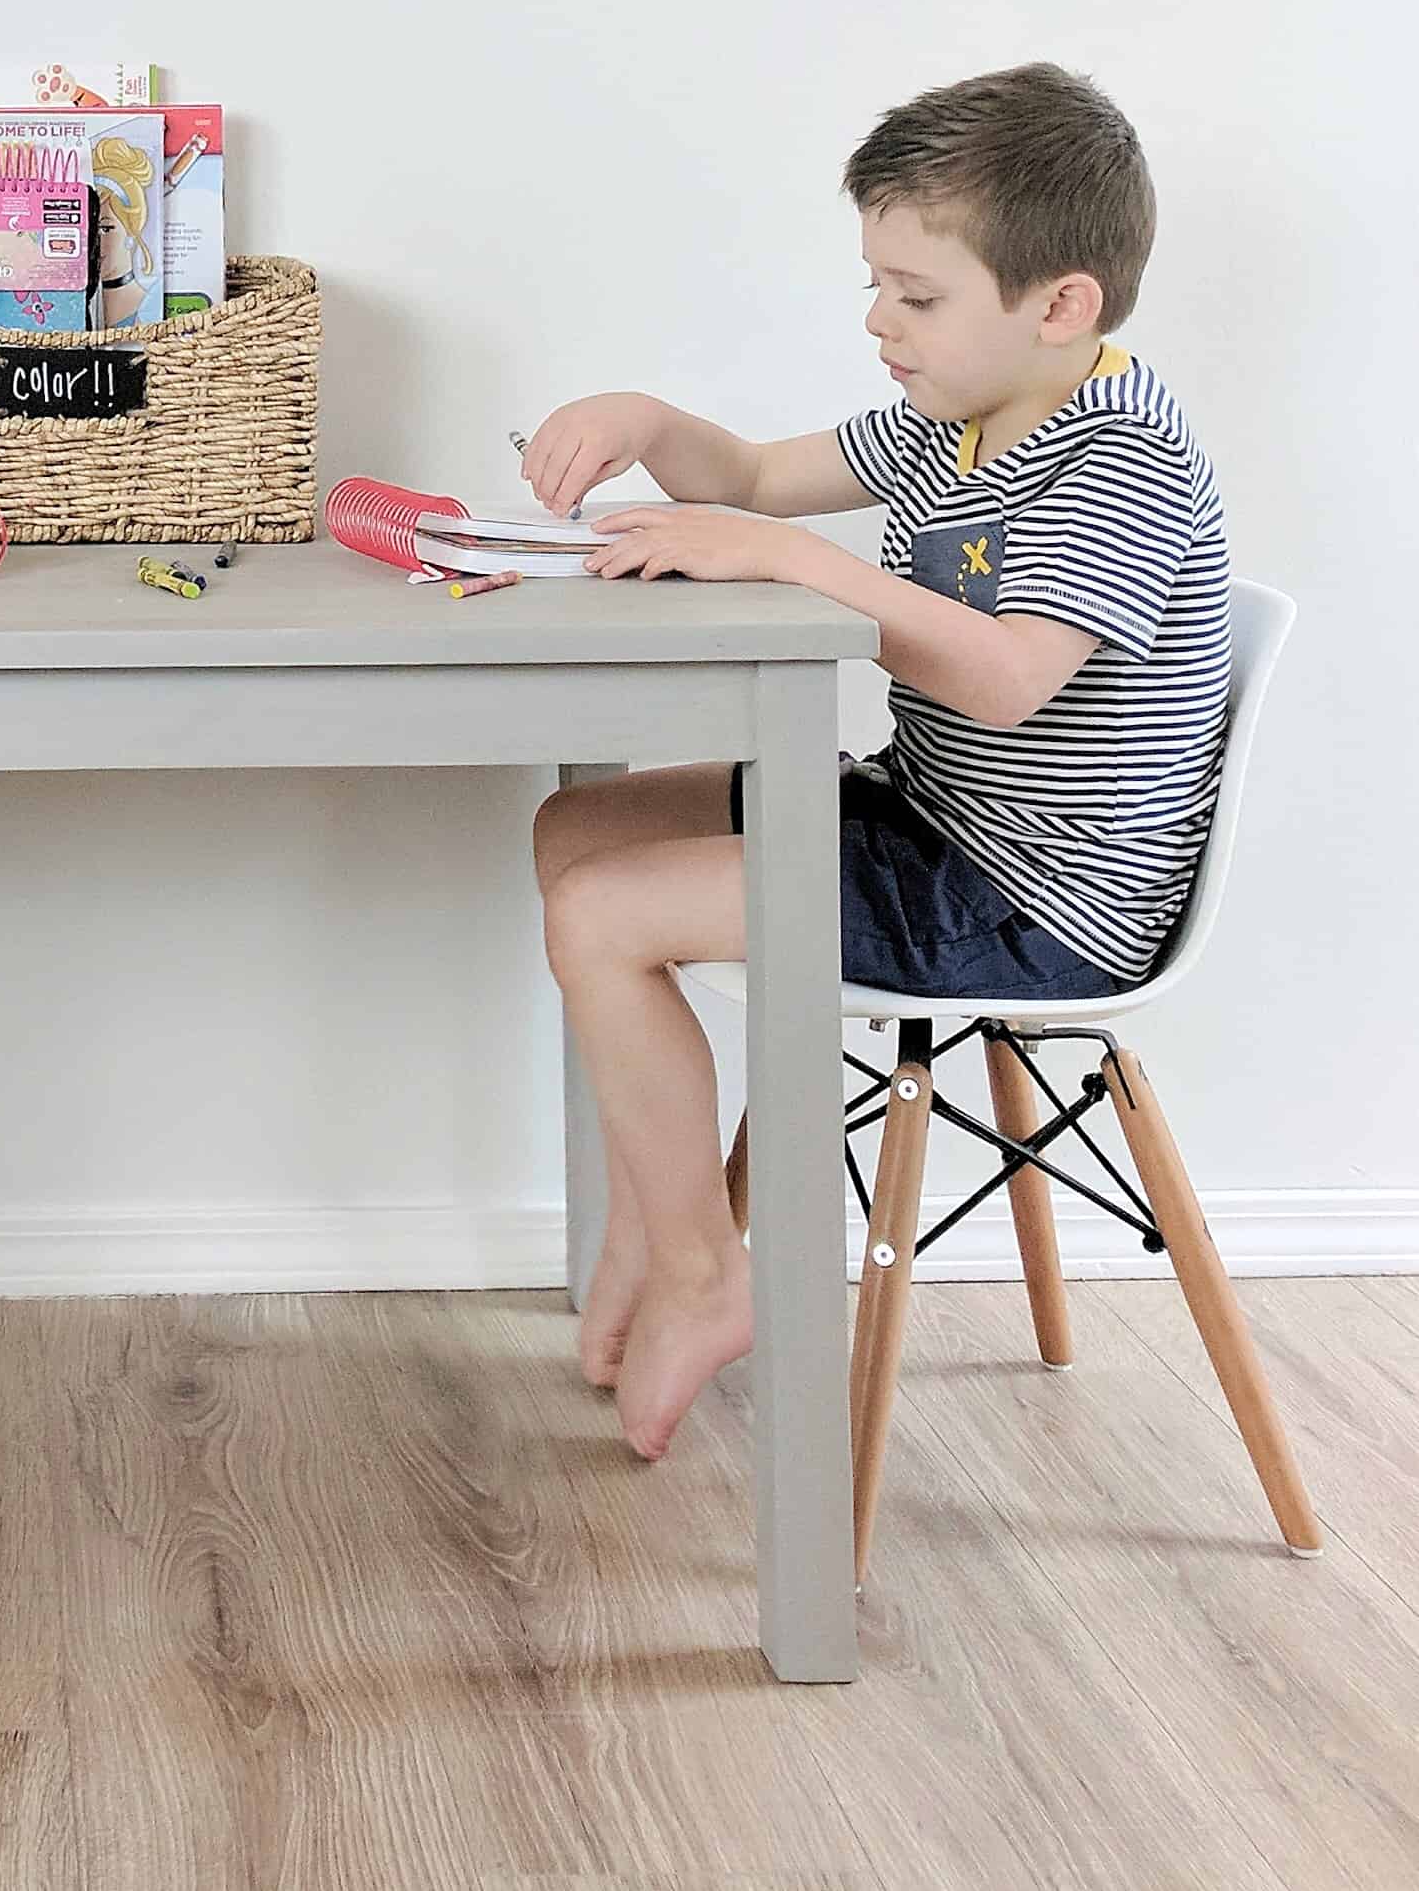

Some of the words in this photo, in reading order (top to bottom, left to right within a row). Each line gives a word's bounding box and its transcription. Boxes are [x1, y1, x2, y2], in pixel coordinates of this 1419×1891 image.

[28, 126, 48, 137] TO
[51, 126, 86, 137] LIFE!
[12, 360, 115, 408] color!!
